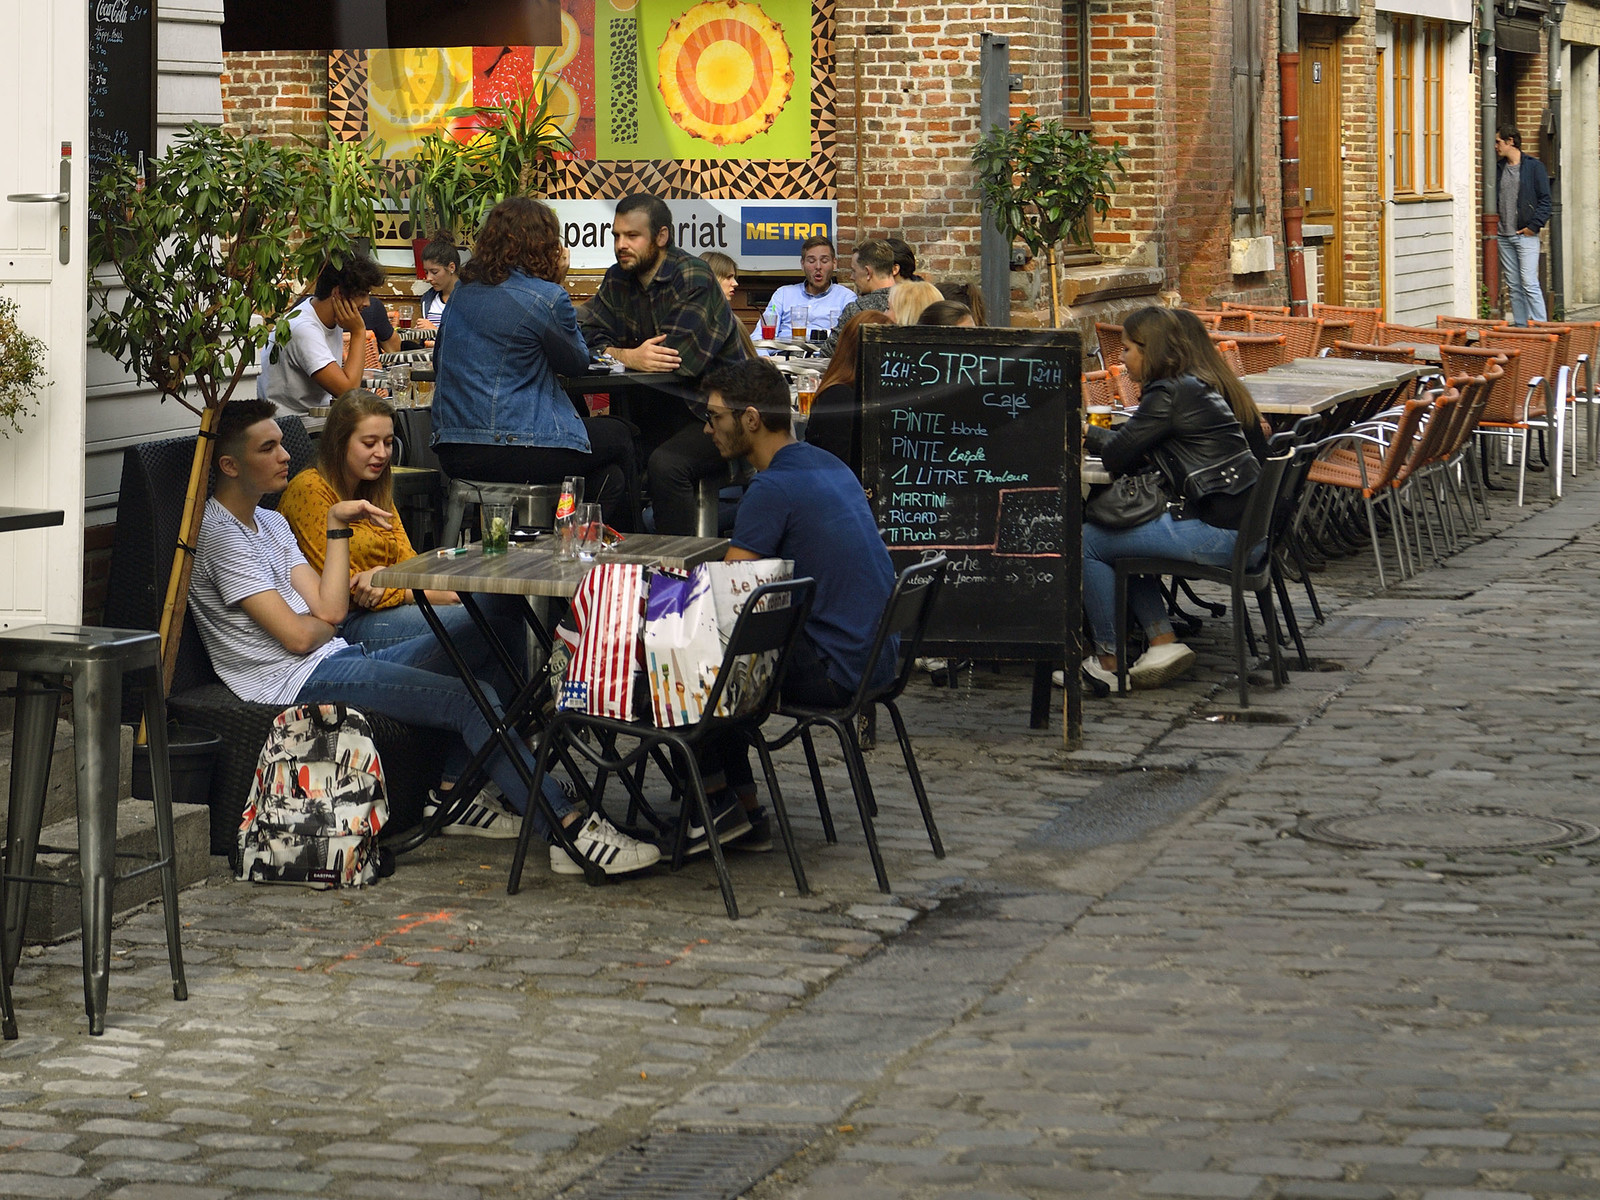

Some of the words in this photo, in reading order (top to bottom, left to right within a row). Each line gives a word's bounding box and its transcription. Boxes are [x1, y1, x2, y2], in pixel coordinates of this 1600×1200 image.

[747, 222, 827, 241] METRO
[880, 360, 910, 379] 16H
[919, 351, 1043, 387] STREET
[1033, 368, 1062, 384] 21H
[950, 420, 989, 437] blonde
[891, 464, 912, 486] 1
[900, 527, 937, 542] Punch
